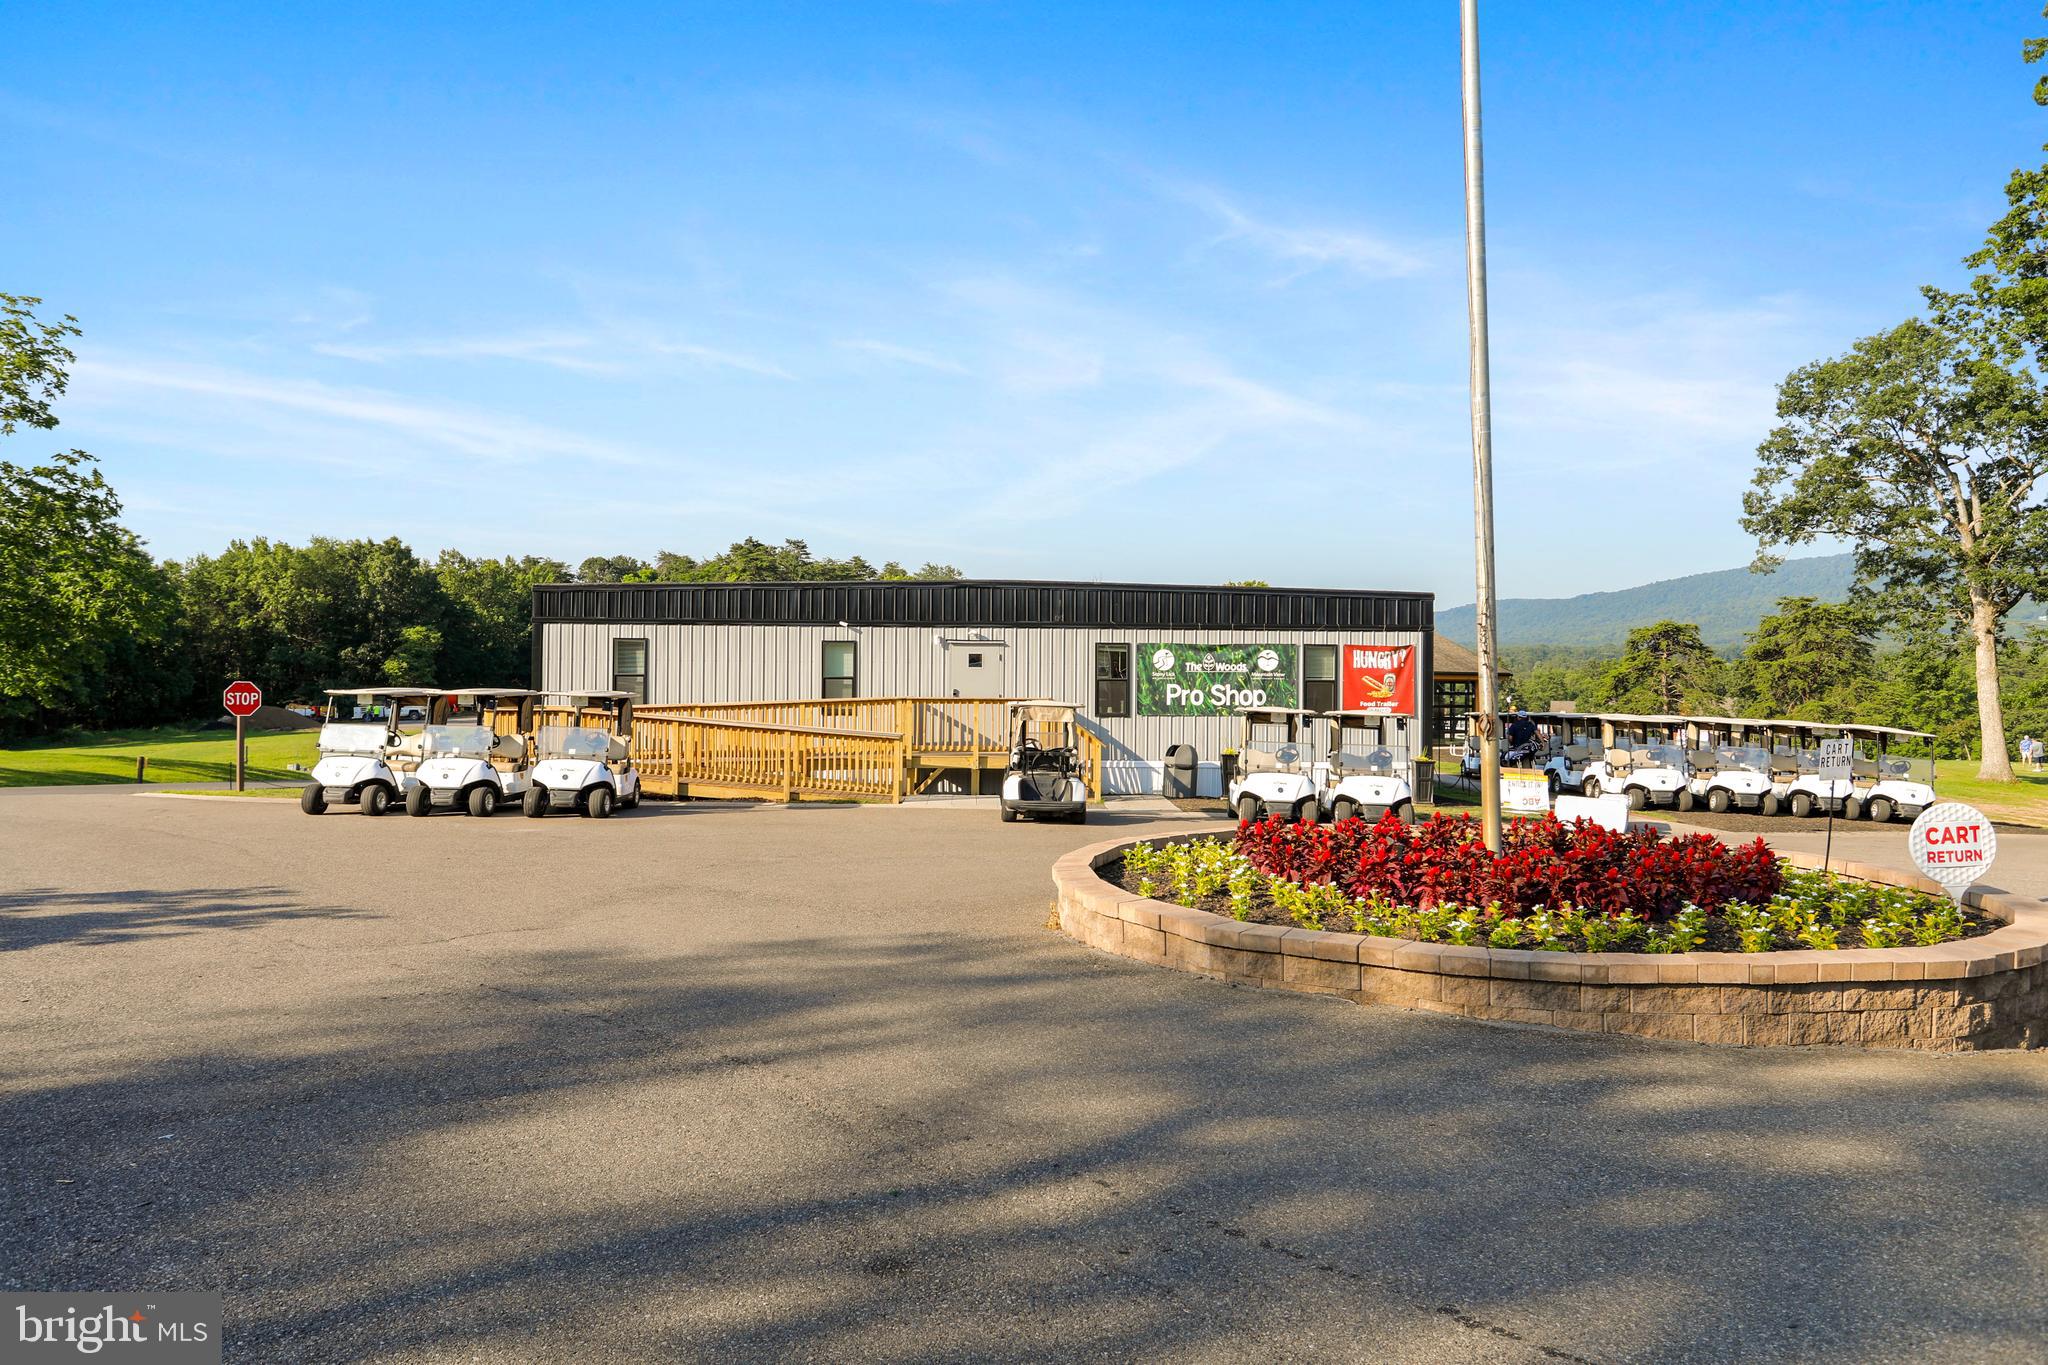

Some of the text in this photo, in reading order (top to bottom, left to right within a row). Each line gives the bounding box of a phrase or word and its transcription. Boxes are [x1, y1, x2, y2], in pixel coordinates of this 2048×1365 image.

[1353, 649, 1406, 669] HUNGRY?
[1185, 662, 1202, 671] The
[226, 692, 259, 705] STOP
[1166, 684, 1267, 708] Pro Shop
[1826, 743, 1849, 755] CART
[1821, 756, 1851, 768] RETURN
[1925, 825, 1980, 845] CART
[1927, 849, 1983, 863] RETURN
